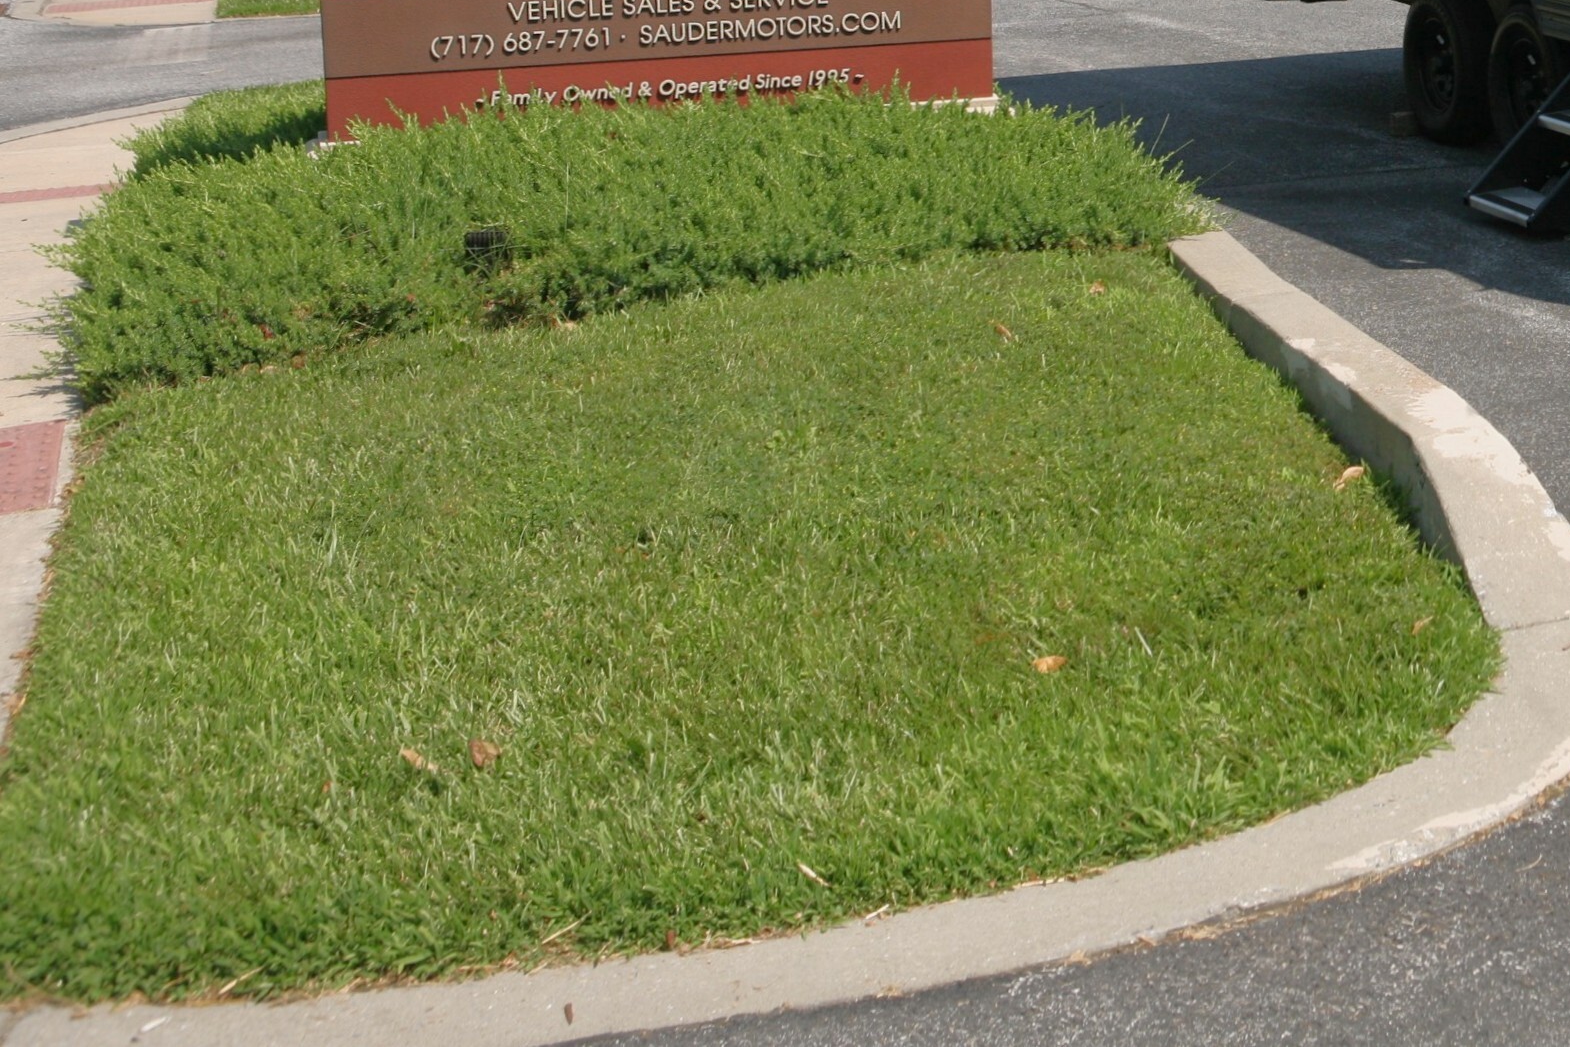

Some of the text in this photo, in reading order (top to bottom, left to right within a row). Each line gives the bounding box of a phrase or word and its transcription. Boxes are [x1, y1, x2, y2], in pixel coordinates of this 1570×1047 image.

[430, 10, 901, 60] (717) 687-7761 SAUDERMOTORS.COM
[639, 81, 653, 97] &
[755, 73, 802, 90] Since
